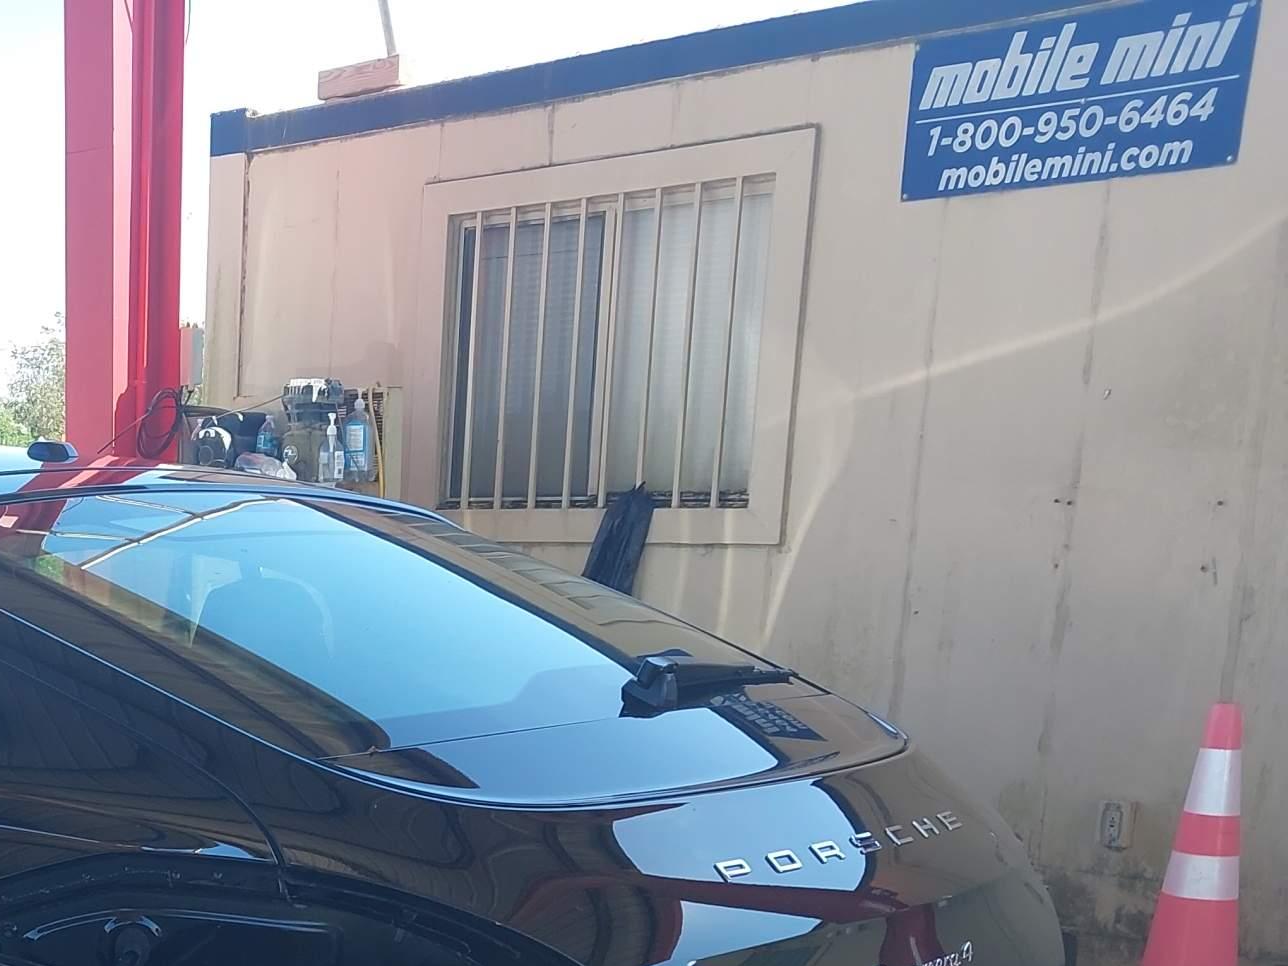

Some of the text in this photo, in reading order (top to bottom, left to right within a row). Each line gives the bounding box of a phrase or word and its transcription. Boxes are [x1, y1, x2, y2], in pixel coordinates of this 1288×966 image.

[919, 2, 1249, 111] mobile mini
[927, 88, 1218, 157] 1-800-950-6464
[938, 140, 1194, 191] mobilemini.com
[714, 810, 963, 883] PORSCHE
